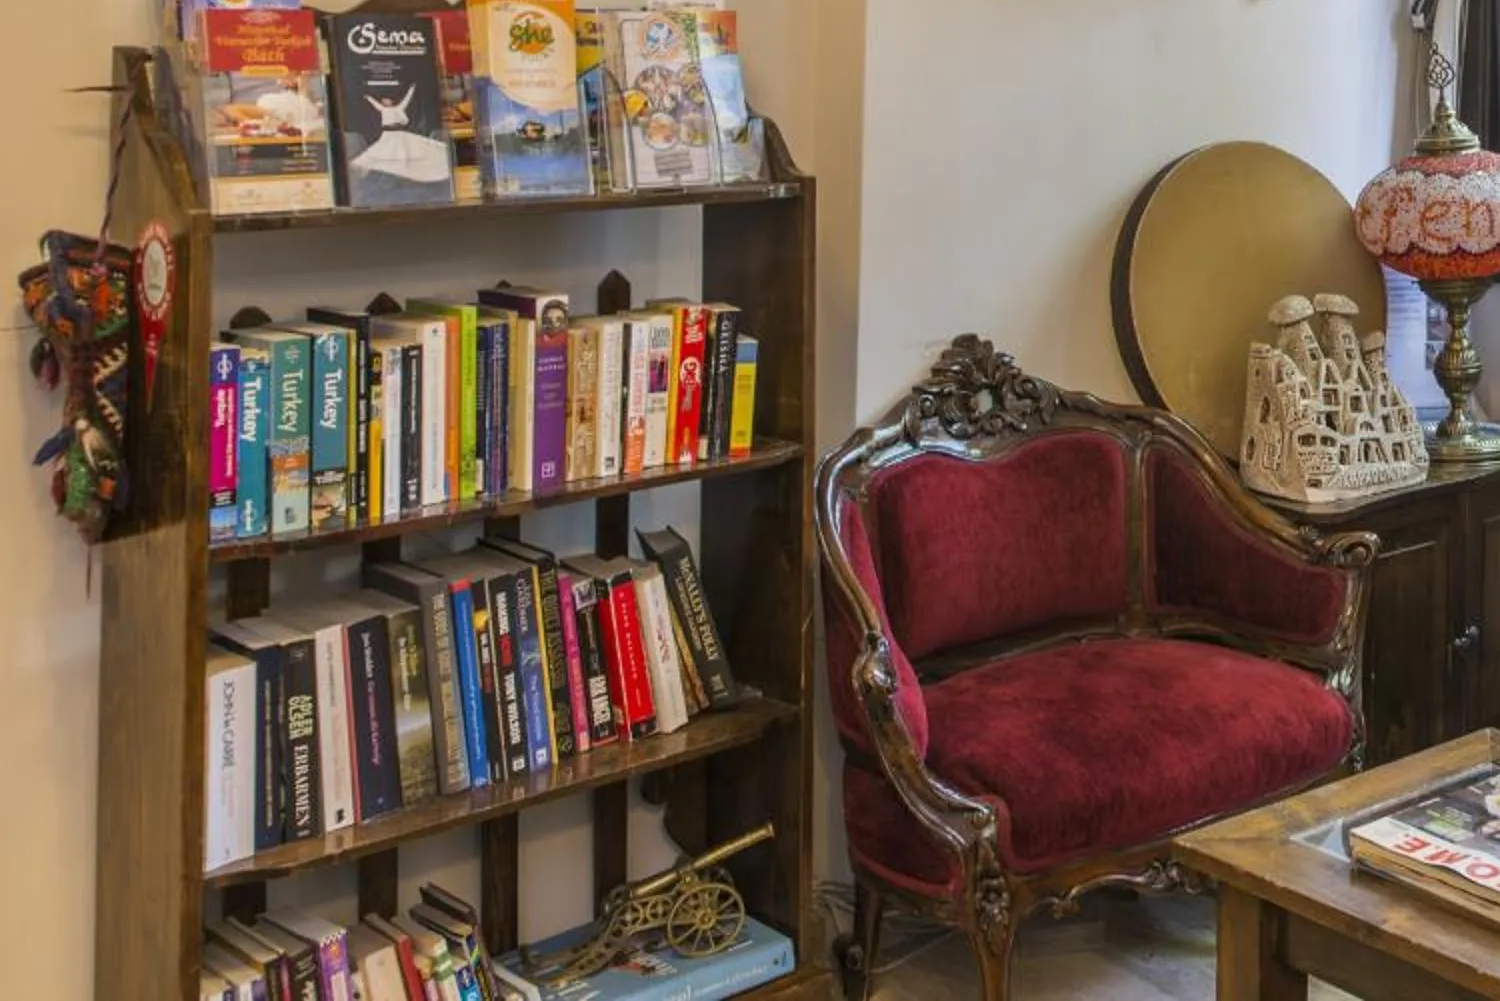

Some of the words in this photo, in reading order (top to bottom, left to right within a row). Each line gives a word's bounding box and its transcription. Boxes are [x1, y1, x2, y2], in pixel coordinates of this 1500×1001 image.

[347, 22, 425, 55] Sema
[240, 376, 262, 442] Turkey
[279, 368, 304, 433] Turkey
[319, 368, 343, 429] Turkey
[292, 743, 311, 827] ERBARMEN
